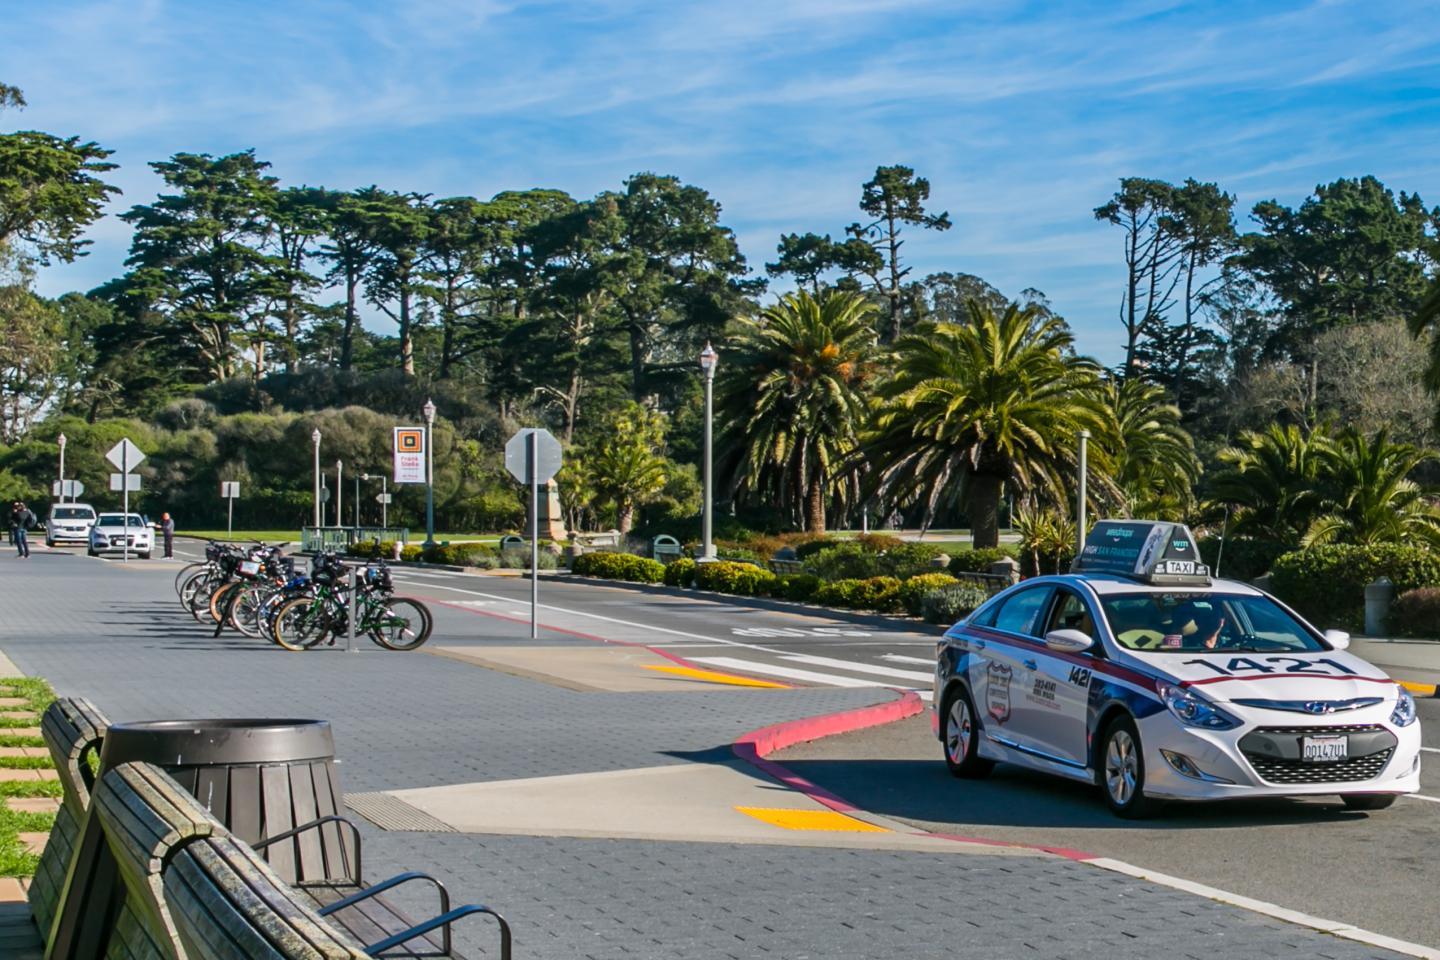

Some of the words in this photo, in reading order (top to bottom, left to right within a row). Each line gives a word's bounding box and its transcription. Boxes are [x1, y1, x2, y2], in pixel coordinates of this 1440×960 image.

[1084, 545, 1098, 555] HIGH
[1172, 540, 1188, 548] wm
[1170, 561, 1192, 573] TAXI
[1182, 657, 1358, 675] 1421
[1069, 665, 1092, 688] 1421
